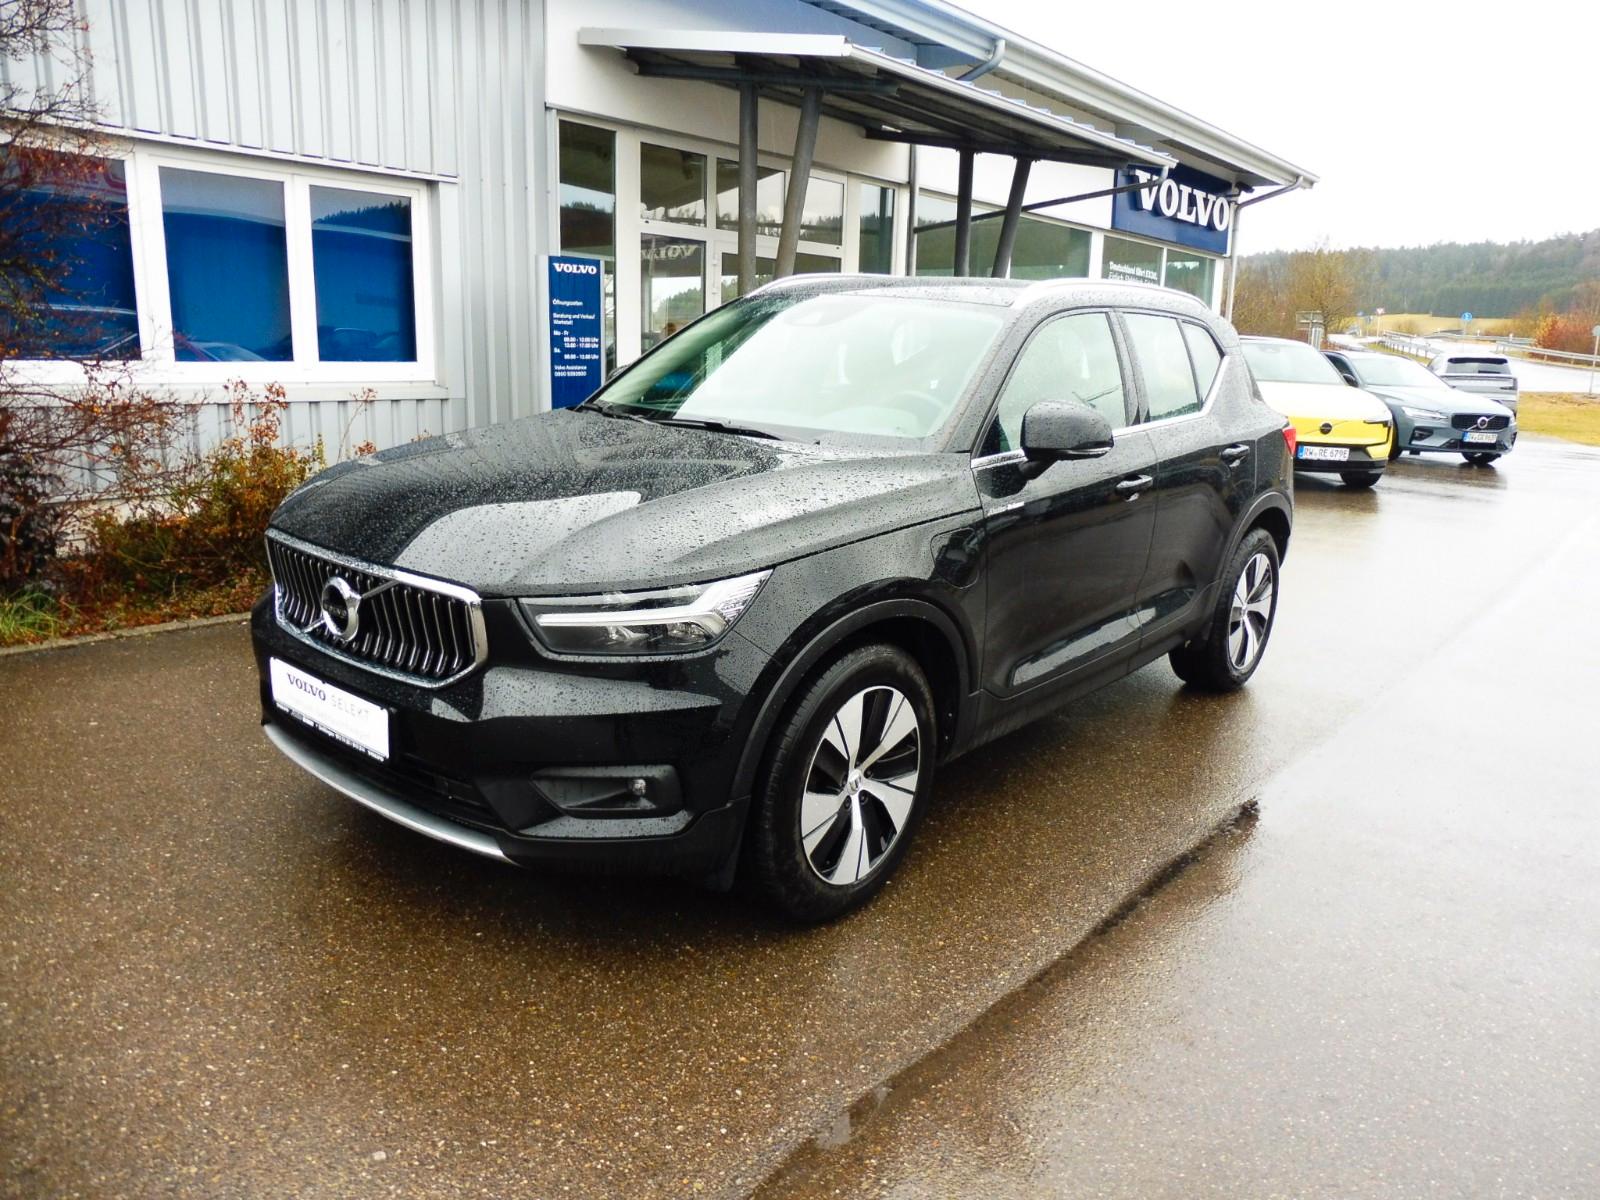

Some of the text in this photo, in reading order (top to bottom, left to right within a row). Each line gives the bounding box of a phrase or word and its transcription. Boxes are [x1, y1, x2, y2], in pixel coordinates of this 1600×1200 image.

[1135, 169, 1230, 231] VOLVO
[552, 262, 597, 275] VOLVO
[552, 298, 583, 307] Öffnungszeiten
[286, 672, 327, 702] VOLVO
